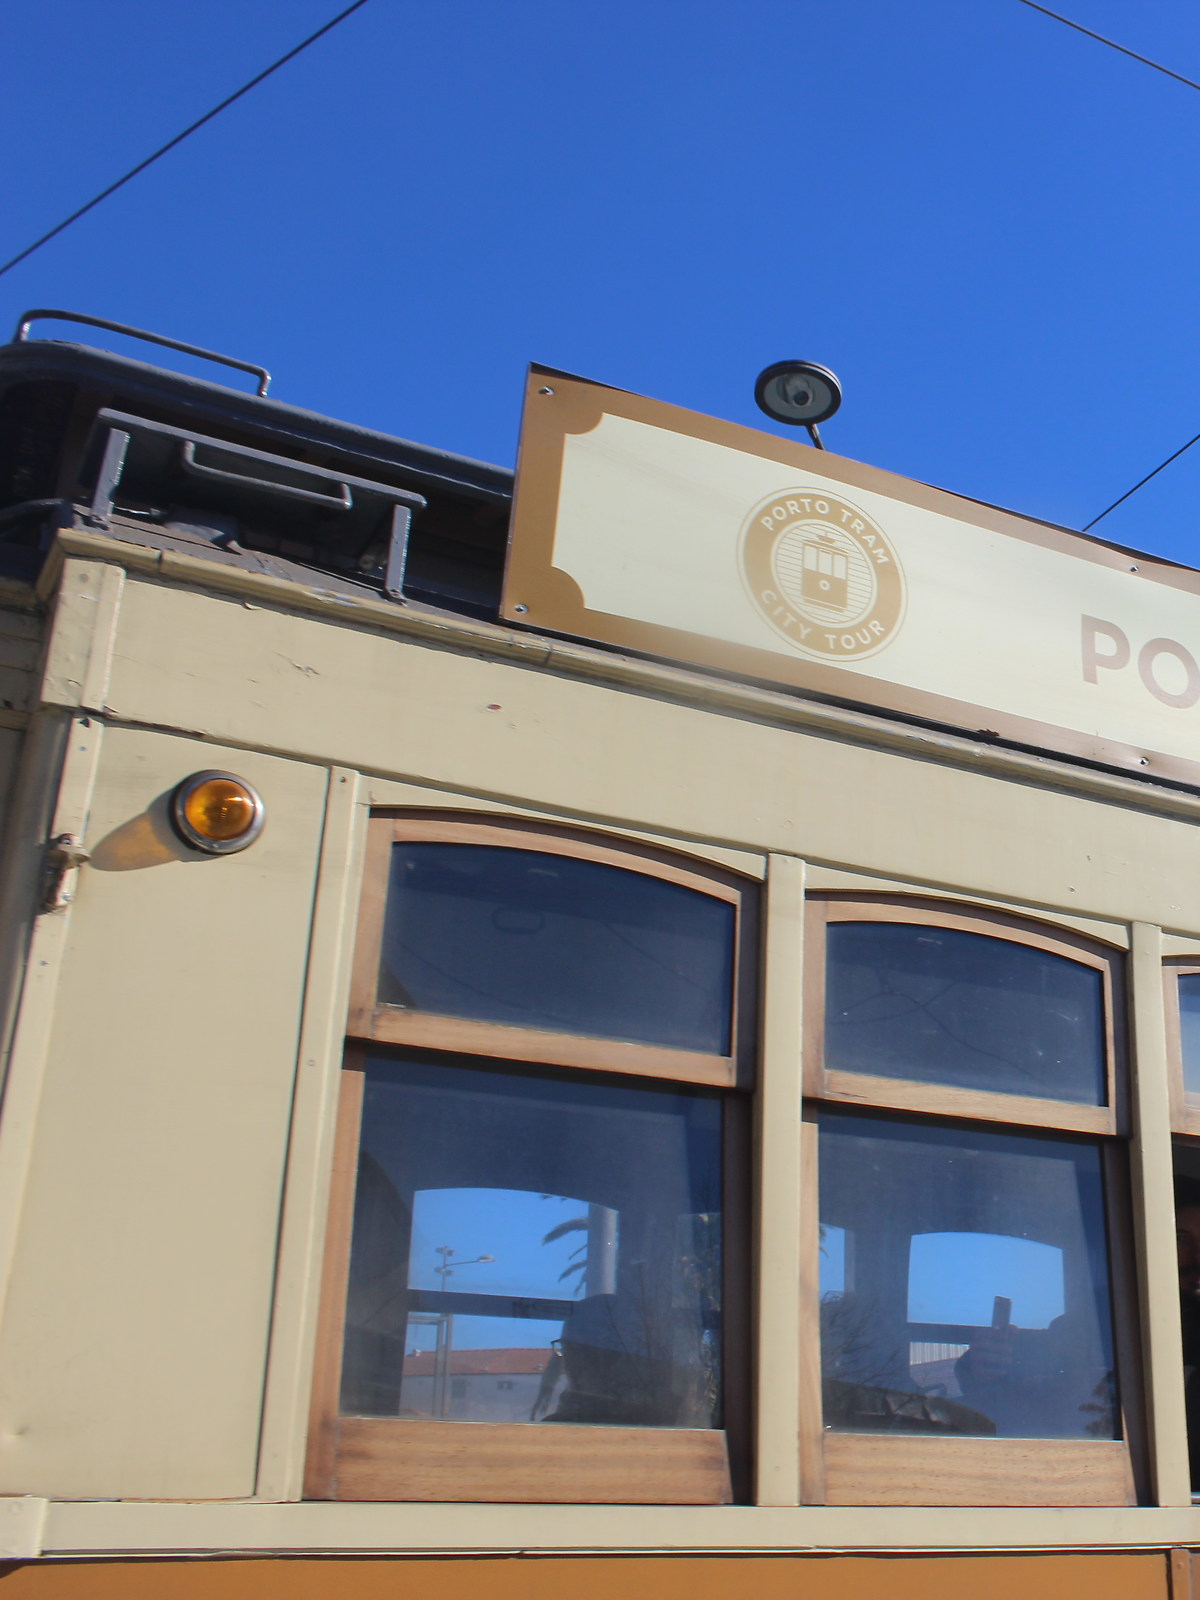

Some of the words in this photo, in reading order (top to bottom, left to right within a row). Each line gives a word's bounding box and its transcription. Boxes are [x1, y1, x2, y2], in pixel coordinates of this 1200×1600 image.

[761, 499, 830, 531] PORTO
[840, 509, 889, 564] TRAM
[762, 590, 812, 640] CITY
[824, 620, 885, 649] TOUR
